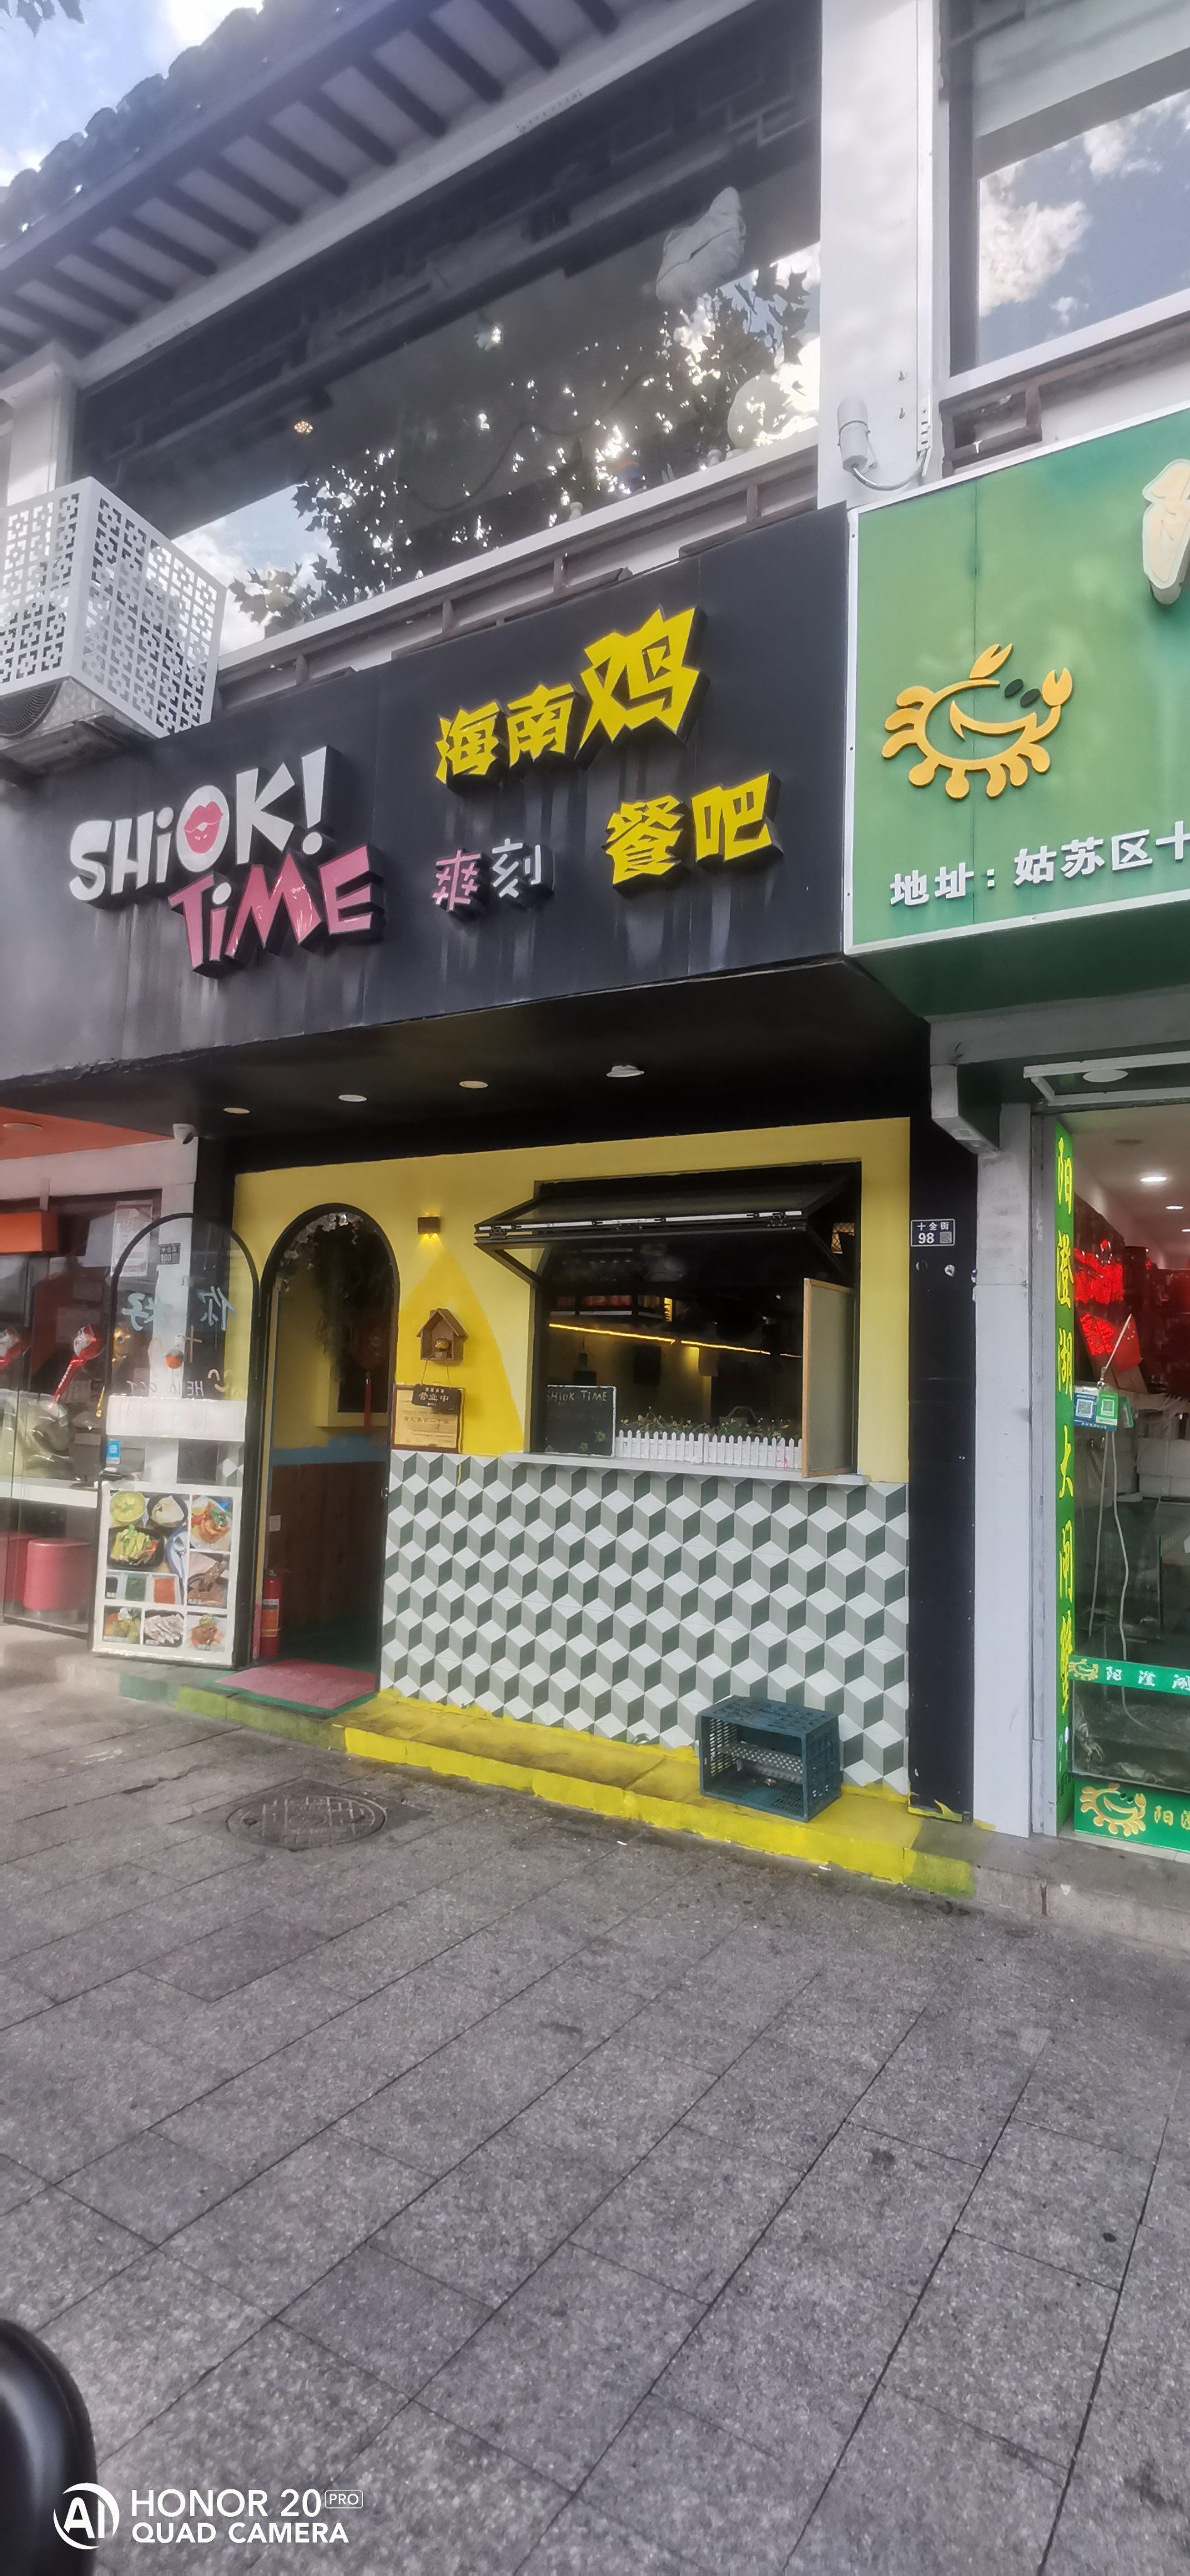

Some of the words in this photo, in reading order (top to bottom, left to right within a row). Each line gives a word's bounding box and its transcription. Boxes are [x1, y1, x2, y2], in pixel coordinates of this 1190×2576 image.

[435, 608, 700, 784] 海南鸡
[601, 772, 772, 884] 餐吧
[432, 838, 543, 911] 爽刻
[917, 1222, 949, 1231] 十全街
[918, 1232, 935, 1244] 98
[418, 1391, 449, 1403] 营业中
[1057, 1136, 1074, 1714] 阳澄湖大闸蟹
